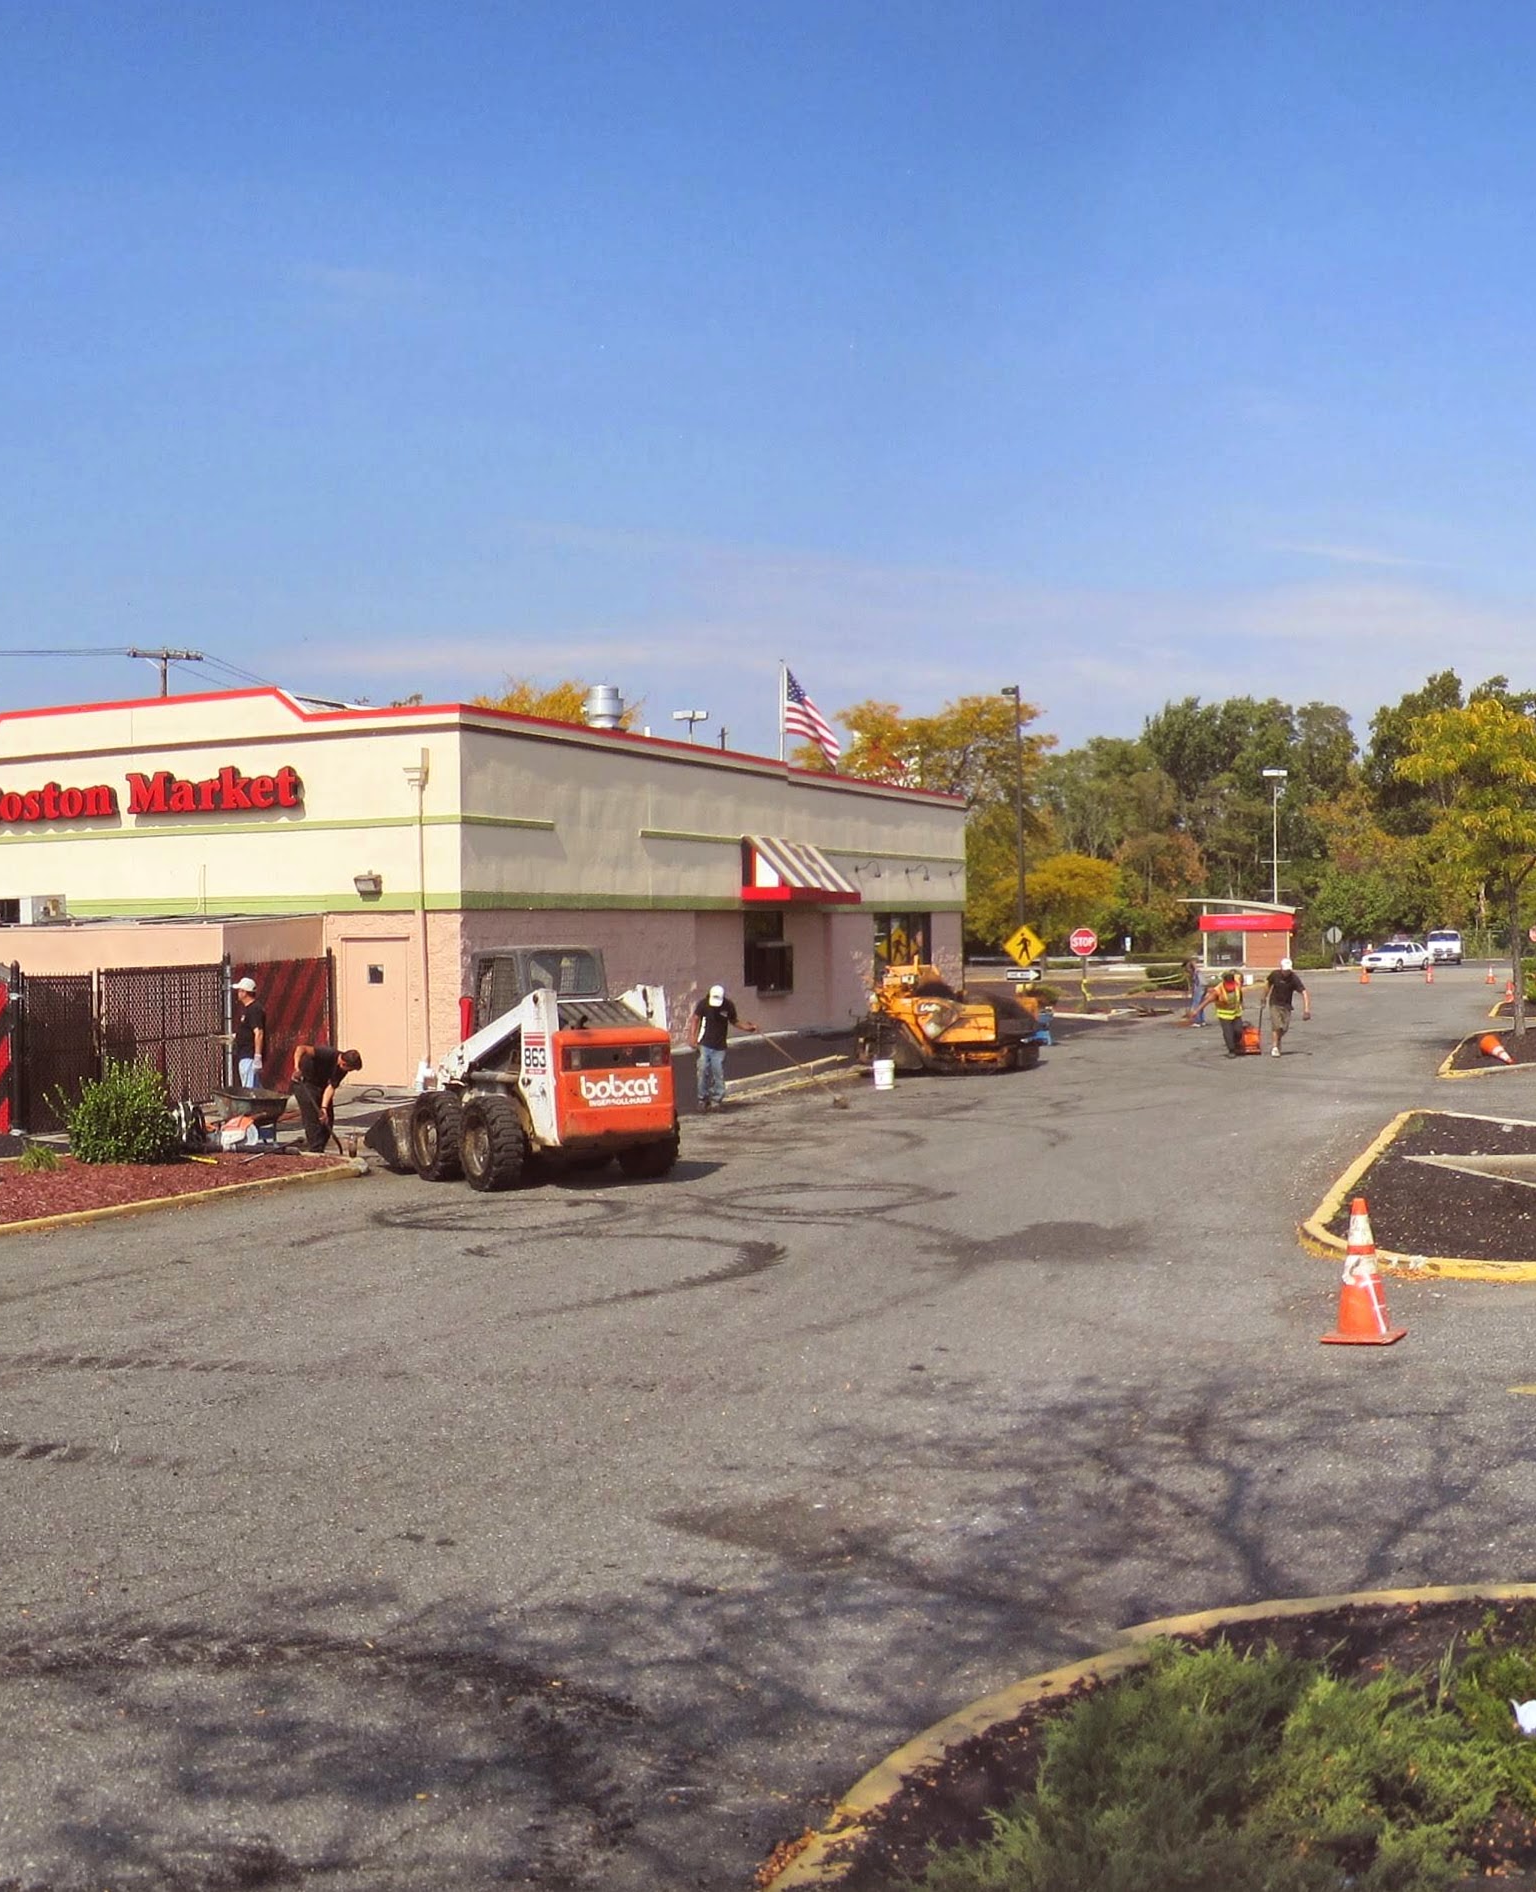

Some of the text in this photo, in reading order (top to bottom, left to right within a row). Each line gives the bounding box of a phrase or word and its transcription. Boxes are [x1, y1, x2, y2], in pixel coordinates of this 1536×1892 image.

[125, 766, 301, 814] Market
[1071, 936, 1095, 948] STOP
[524, 1047, 546, 1068] 863
[580, 1073, 659, 1100] bobcat
